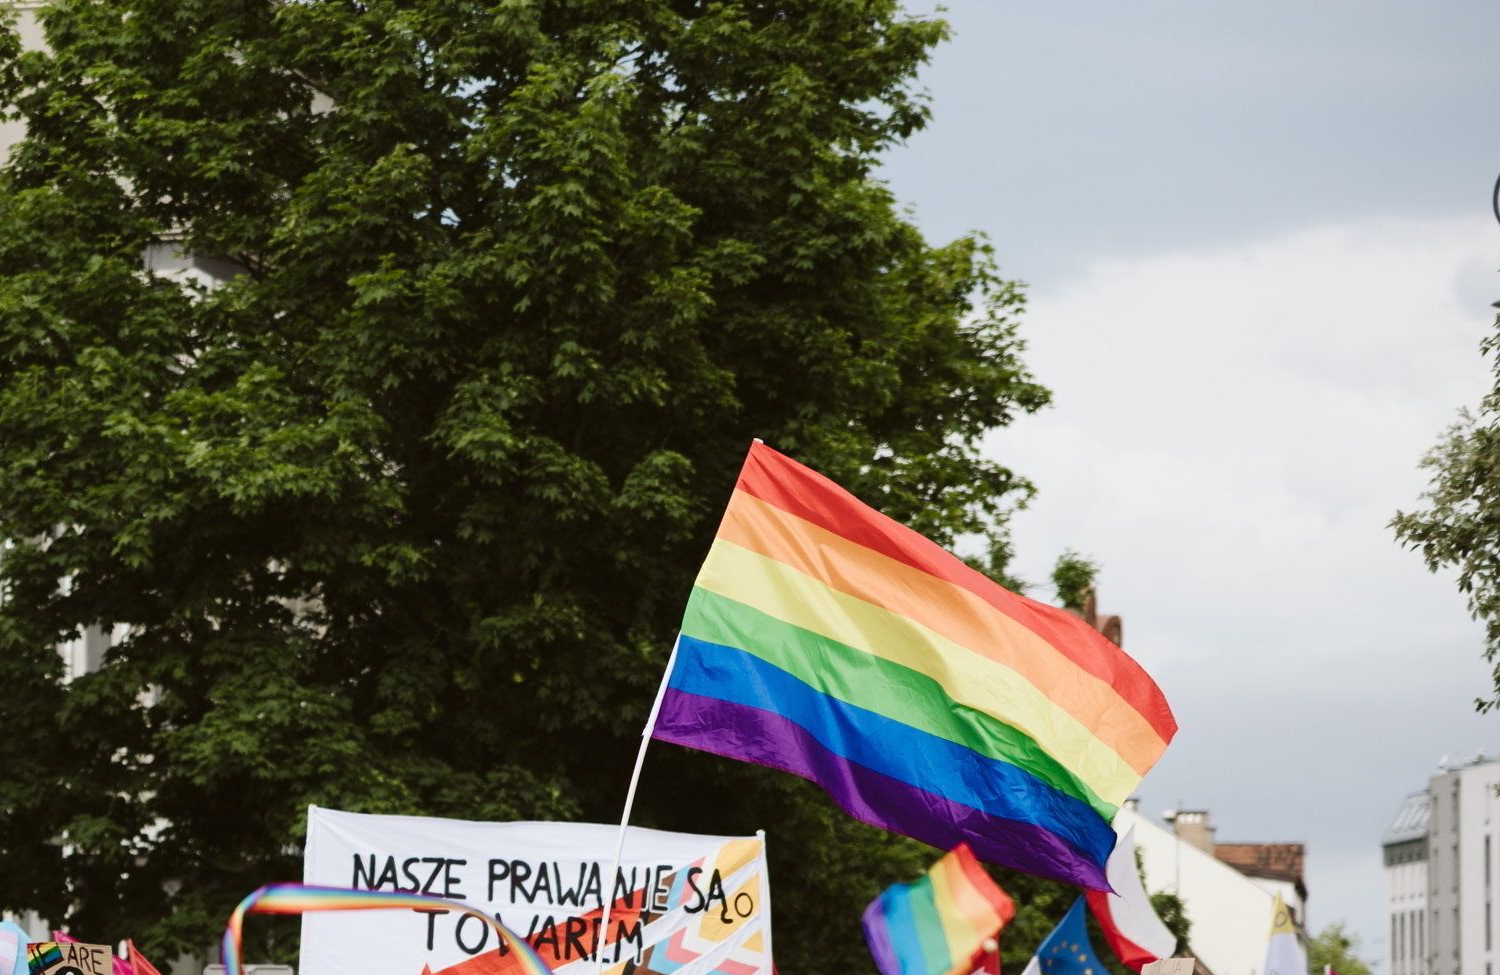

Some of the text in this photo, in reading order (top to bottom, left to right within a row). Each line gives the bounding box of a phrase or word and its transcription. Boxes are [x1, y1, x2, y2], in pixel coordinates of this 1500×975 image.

[353, 853, 467, 900] NASZE
[683, 866, 734, 925] SĄ
[413, 908, 644, 964] TOWAREM
